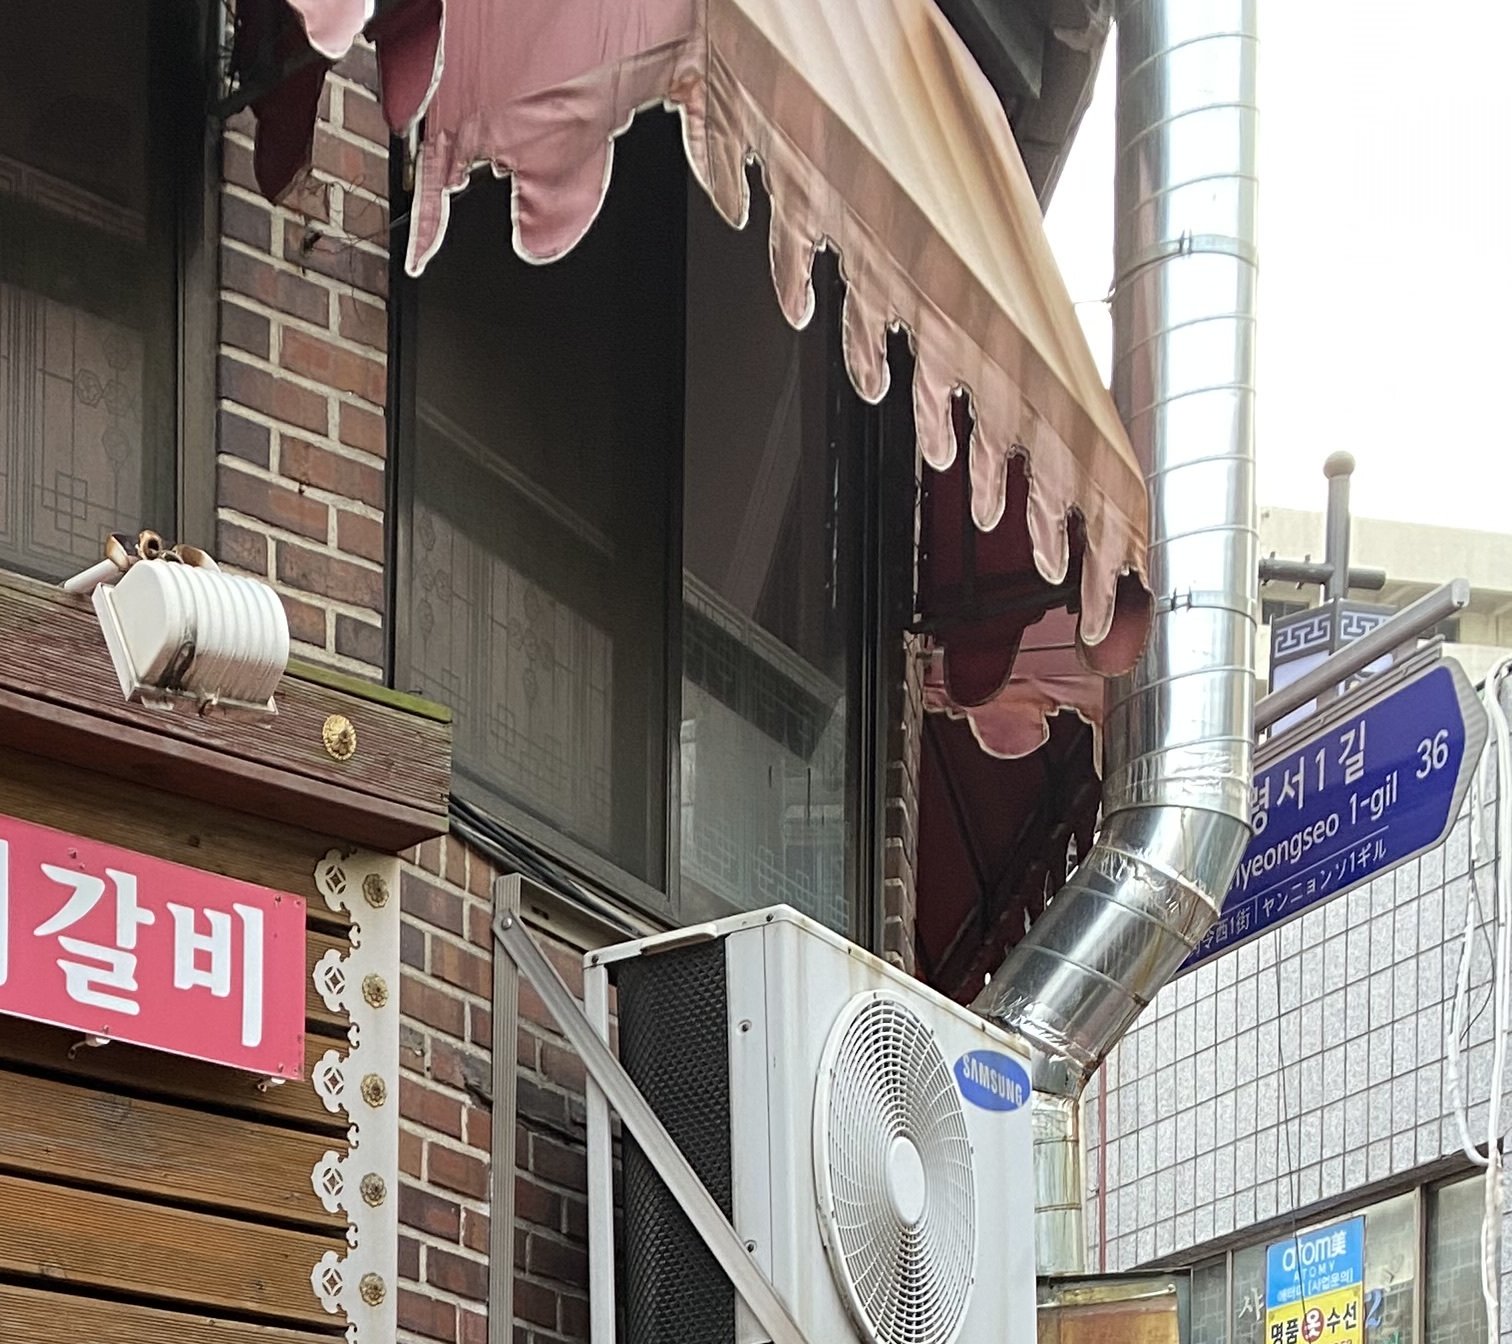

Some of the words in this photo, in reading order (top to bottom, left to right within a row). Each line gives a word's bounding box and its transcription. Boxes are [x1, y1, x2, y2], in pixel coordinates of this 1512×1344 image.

[1415, 729, 1449, 780] 36
[1349, 770, 1398, 825] 1-gil
[961, 1052, 1024, 1107] SAMSUNG
[1326, 1300, 1358, 1334] 수선
